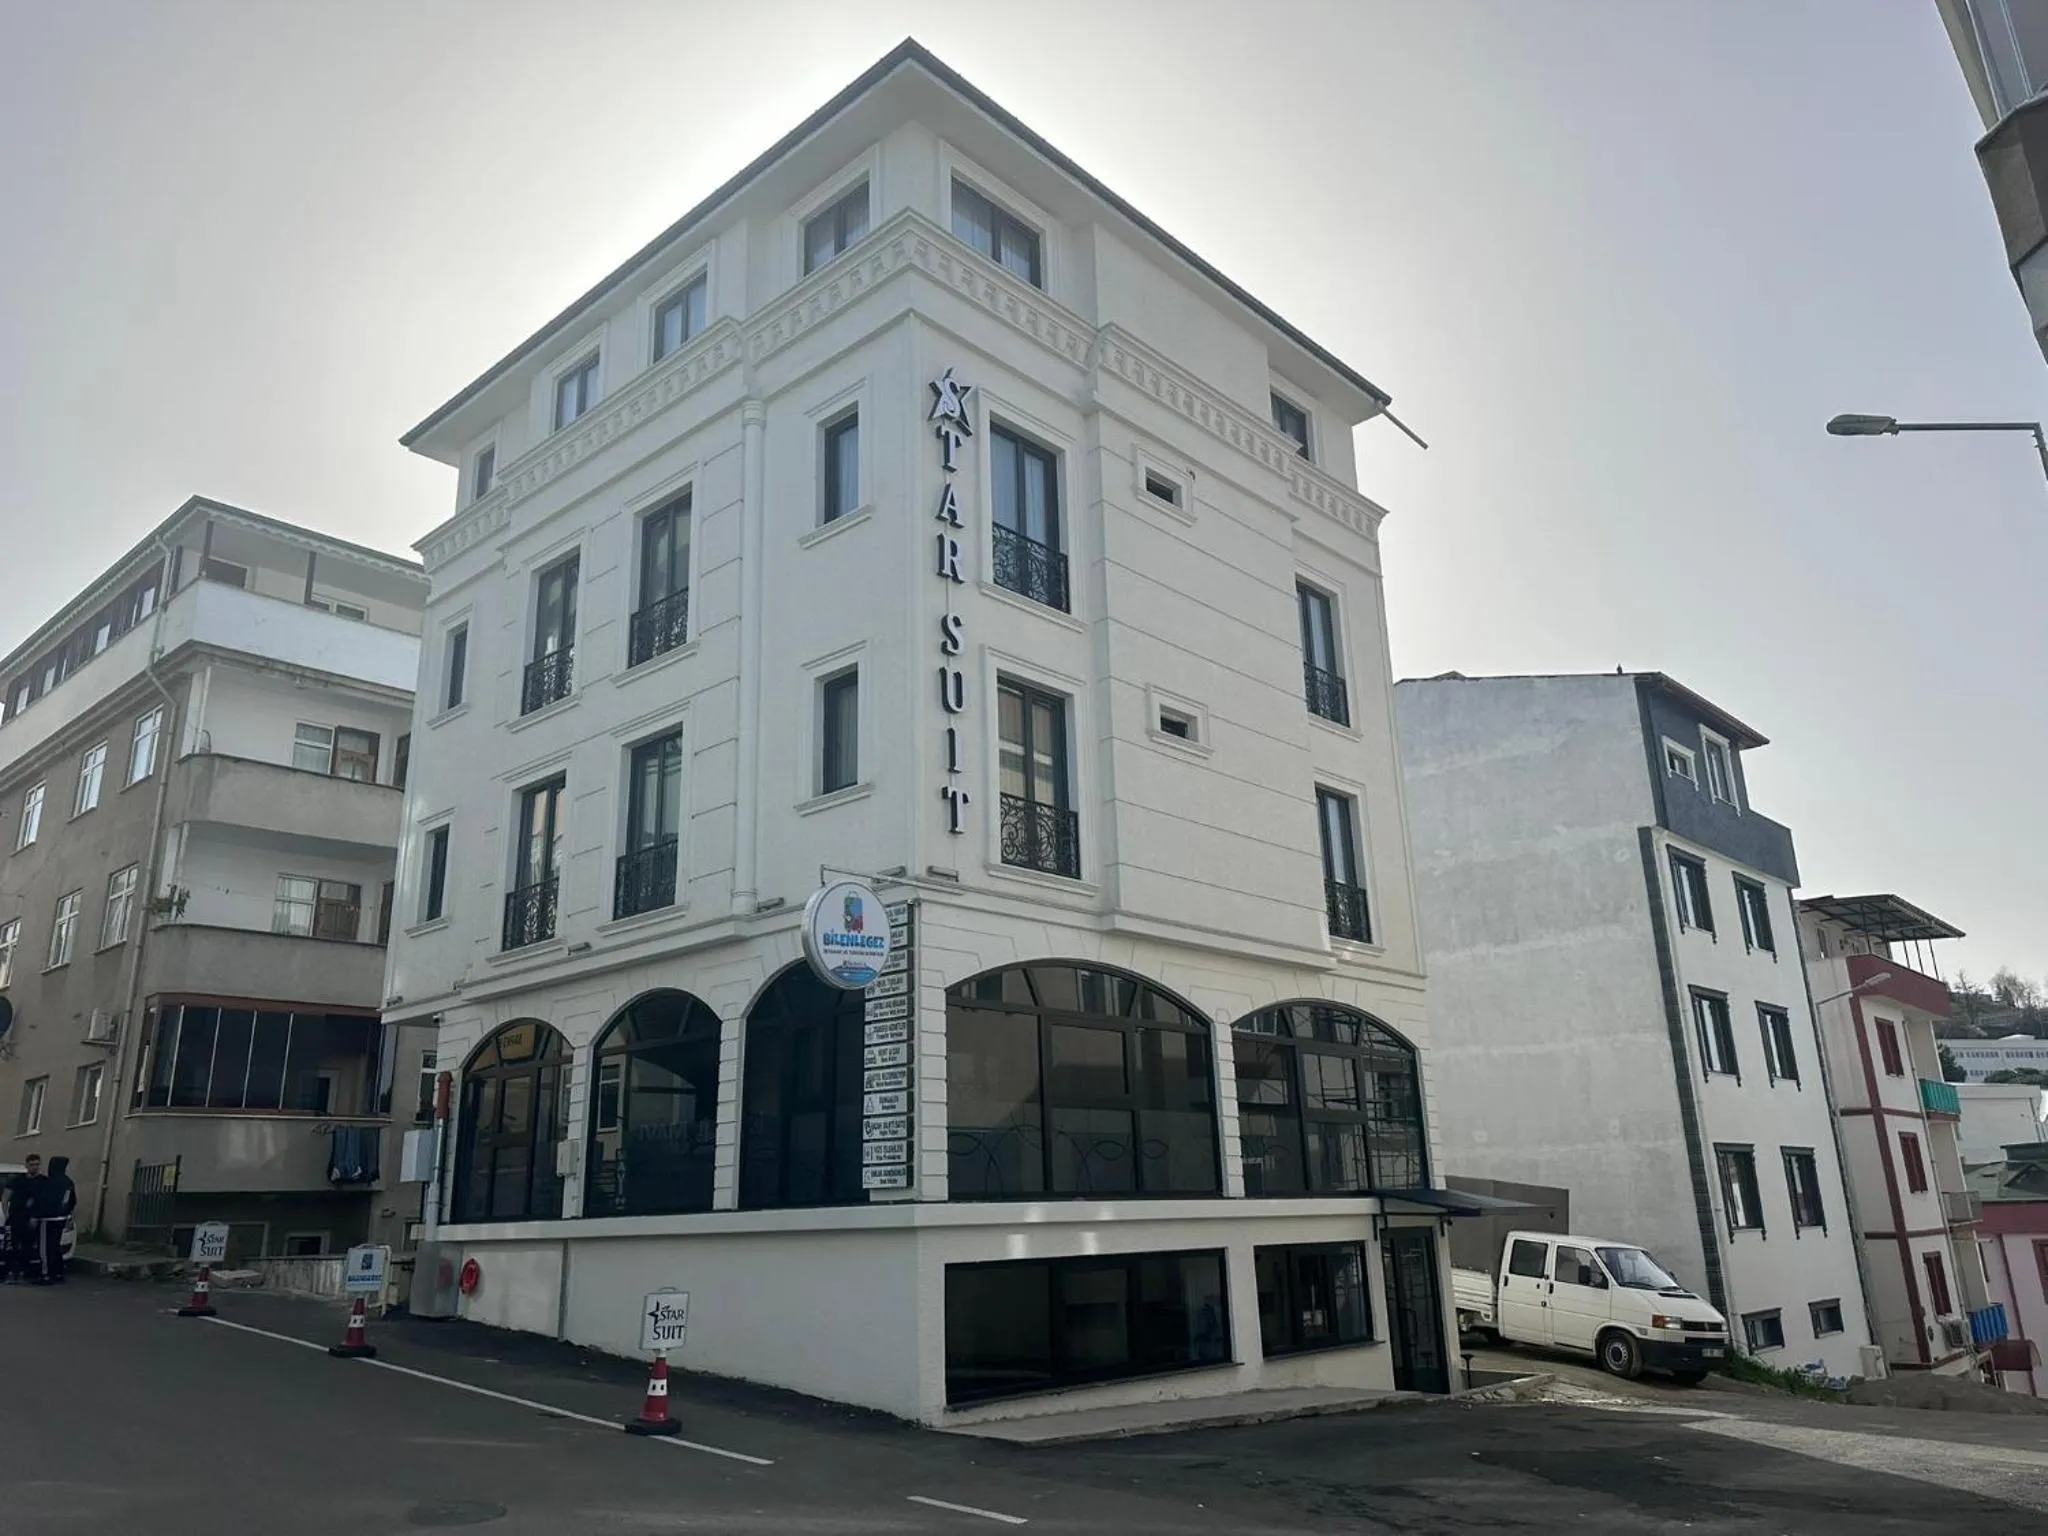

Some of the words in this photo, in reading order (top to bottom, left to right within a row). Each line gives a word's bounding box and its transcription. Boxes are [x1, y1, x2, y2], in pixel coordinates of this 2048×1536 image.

[935, 377, 966, 584] STAR
[939, 613, 969, 834] SUIT
[652, 1325, 686, 1341] SUIT
[659, 1305, 685, 1321] STAR
